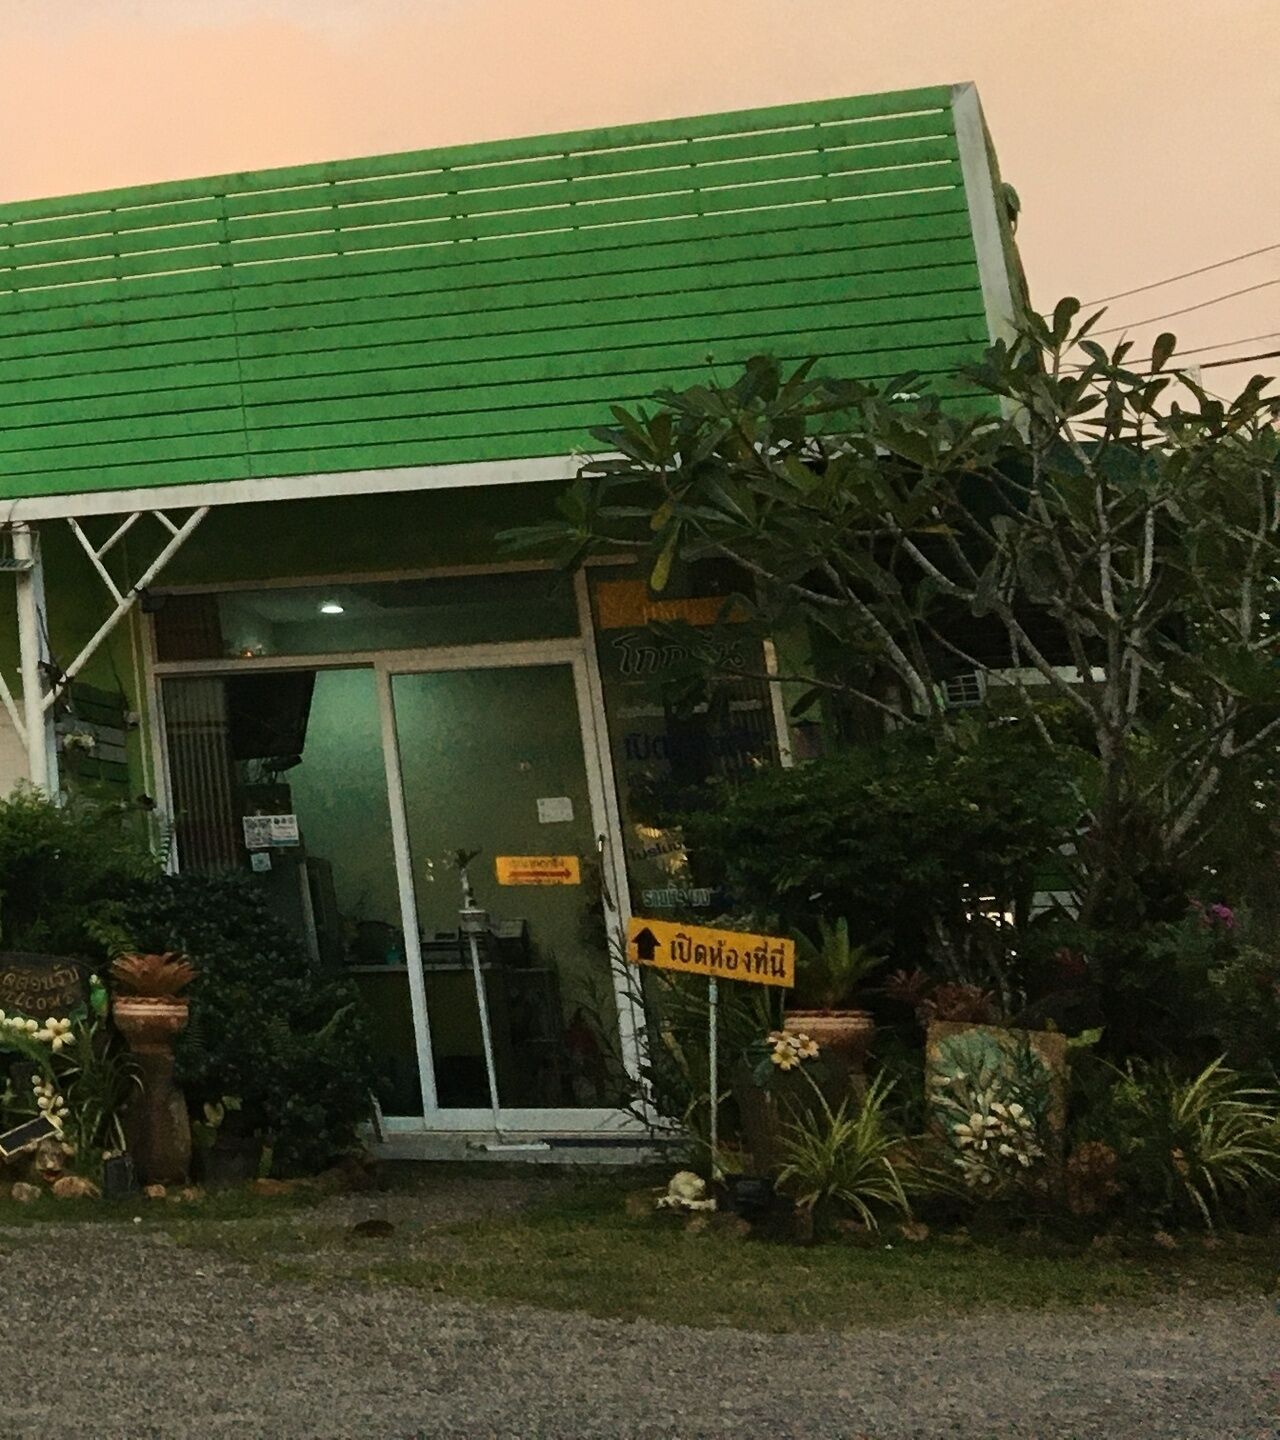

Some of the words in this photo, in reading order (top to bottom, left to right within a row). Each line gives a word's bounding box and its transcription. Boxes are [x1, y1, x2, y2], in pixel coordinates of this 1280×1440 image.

[670, 933, 785, 978] เปิดห้องที่นี่
